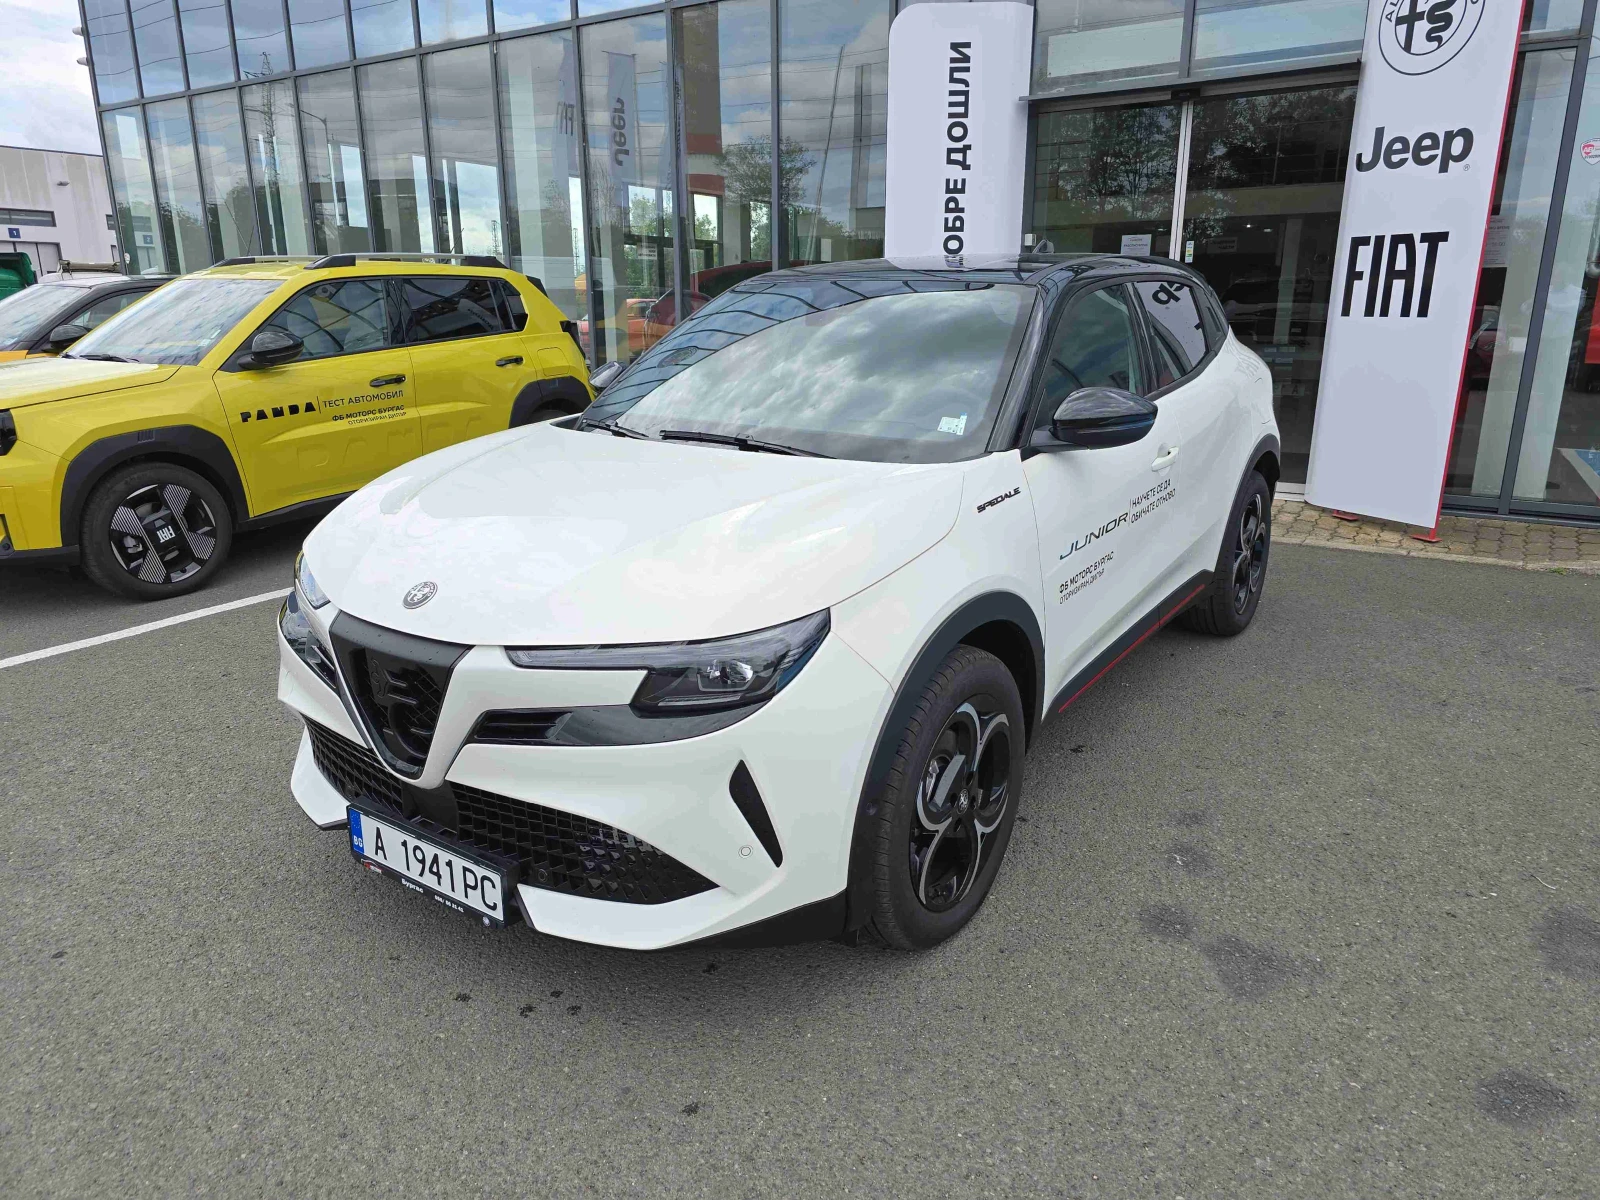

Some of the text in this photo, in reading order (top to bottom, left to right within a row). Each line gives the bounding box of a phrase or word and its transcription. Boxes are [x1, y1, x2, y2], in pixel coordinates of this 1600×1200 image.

[943, 41, 972, 256] ОБРЕ ДОШЛИ
[1355, 126, 1474, 174] Jeep
[1341, 231, 1450, 318] FIAT
[239, 401, 317, 423] PANDA
[322, 389, 404, 409] ТЕСТ АВТОМОБИЛ
[332, 404, 405, 422] ФБ МОТОРС БУРГАС
[1130, 488, 1176, 524] ОБИЧАТЕ ОТНОВО
[1132, 487, 1156, 509] НАУЧЕТЕ
[1059, 512, 1129, 561] JUNIOR
[1070, 564, 1093, 587] МОТОРС
[1093, 551, 1114, 571] БУРГАС
[353, 835, 363, 848] BG
[374, 826, 388, 861] A
